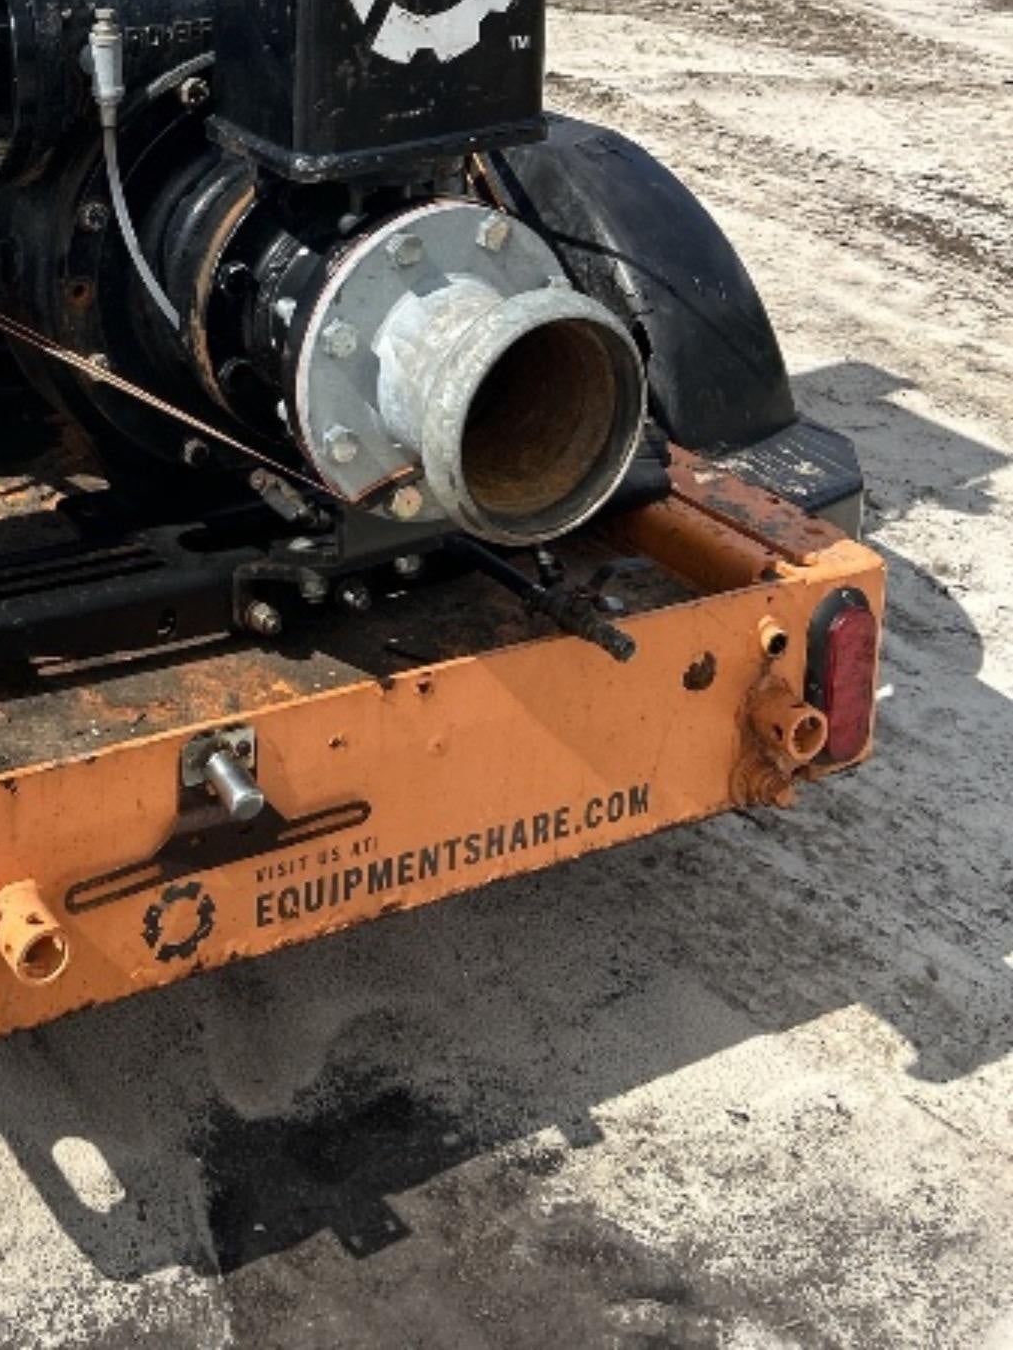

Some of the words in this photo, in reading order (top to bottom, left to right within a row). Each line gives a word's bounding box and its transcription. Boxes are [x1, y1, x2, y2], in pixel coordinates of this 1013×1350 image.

[508, 35, 532, 52] TM
[255, 782, 651, 928] EQUIPMENTSHARE.COM
[255, 854, 310, 883] VISIT
[317, 845, 340, 865] US
